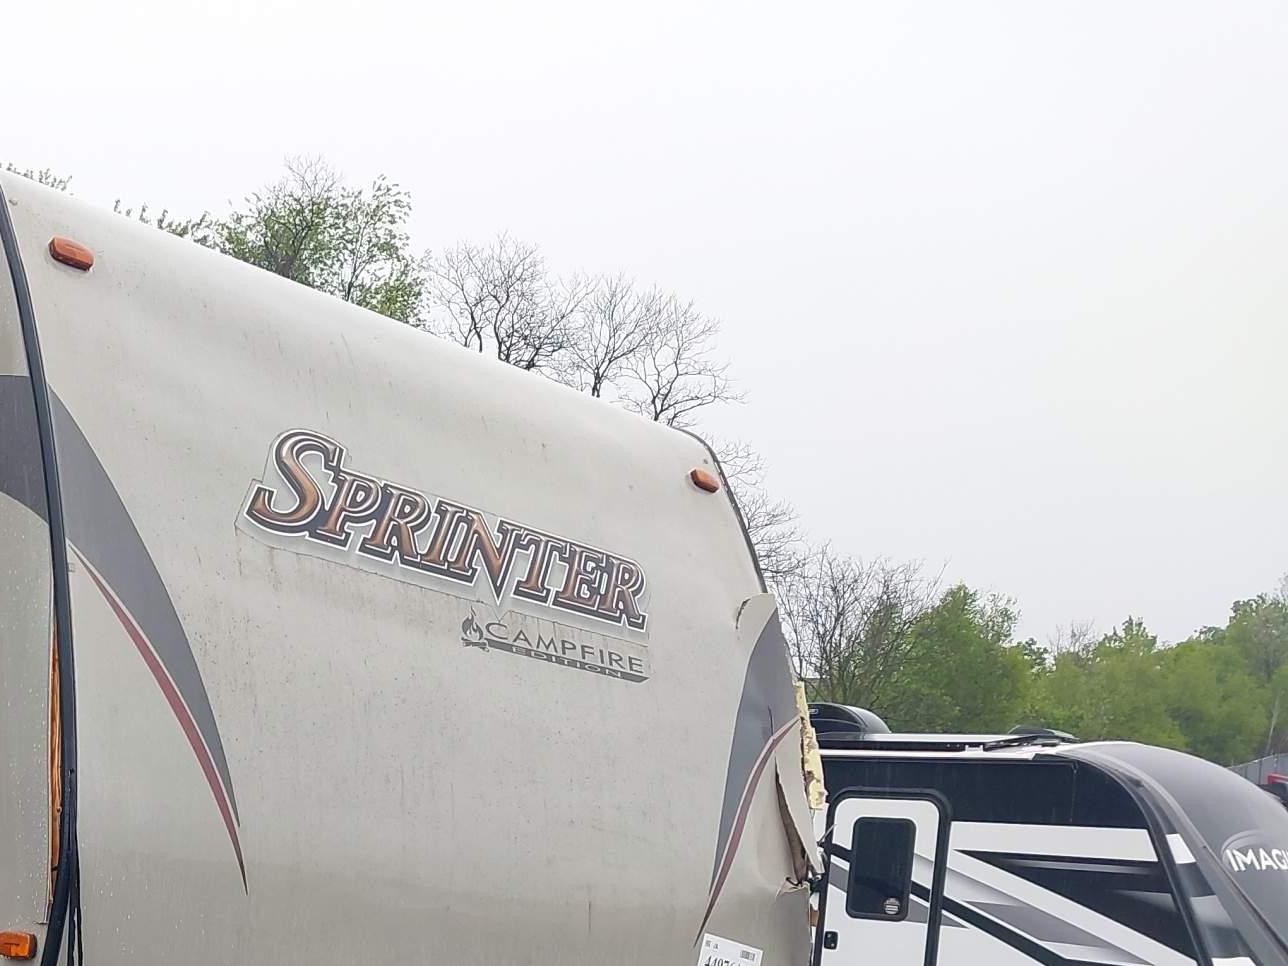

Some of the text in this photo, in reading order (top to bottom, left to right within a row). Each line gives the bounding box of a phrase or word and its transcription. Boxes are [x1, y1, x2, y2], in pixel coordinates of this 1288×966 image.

[244, 428, 648, 633] SPRINTER
[485, 622, 644, 674] CAMPFIRE
[511, 646, 622, 679] EDITION
